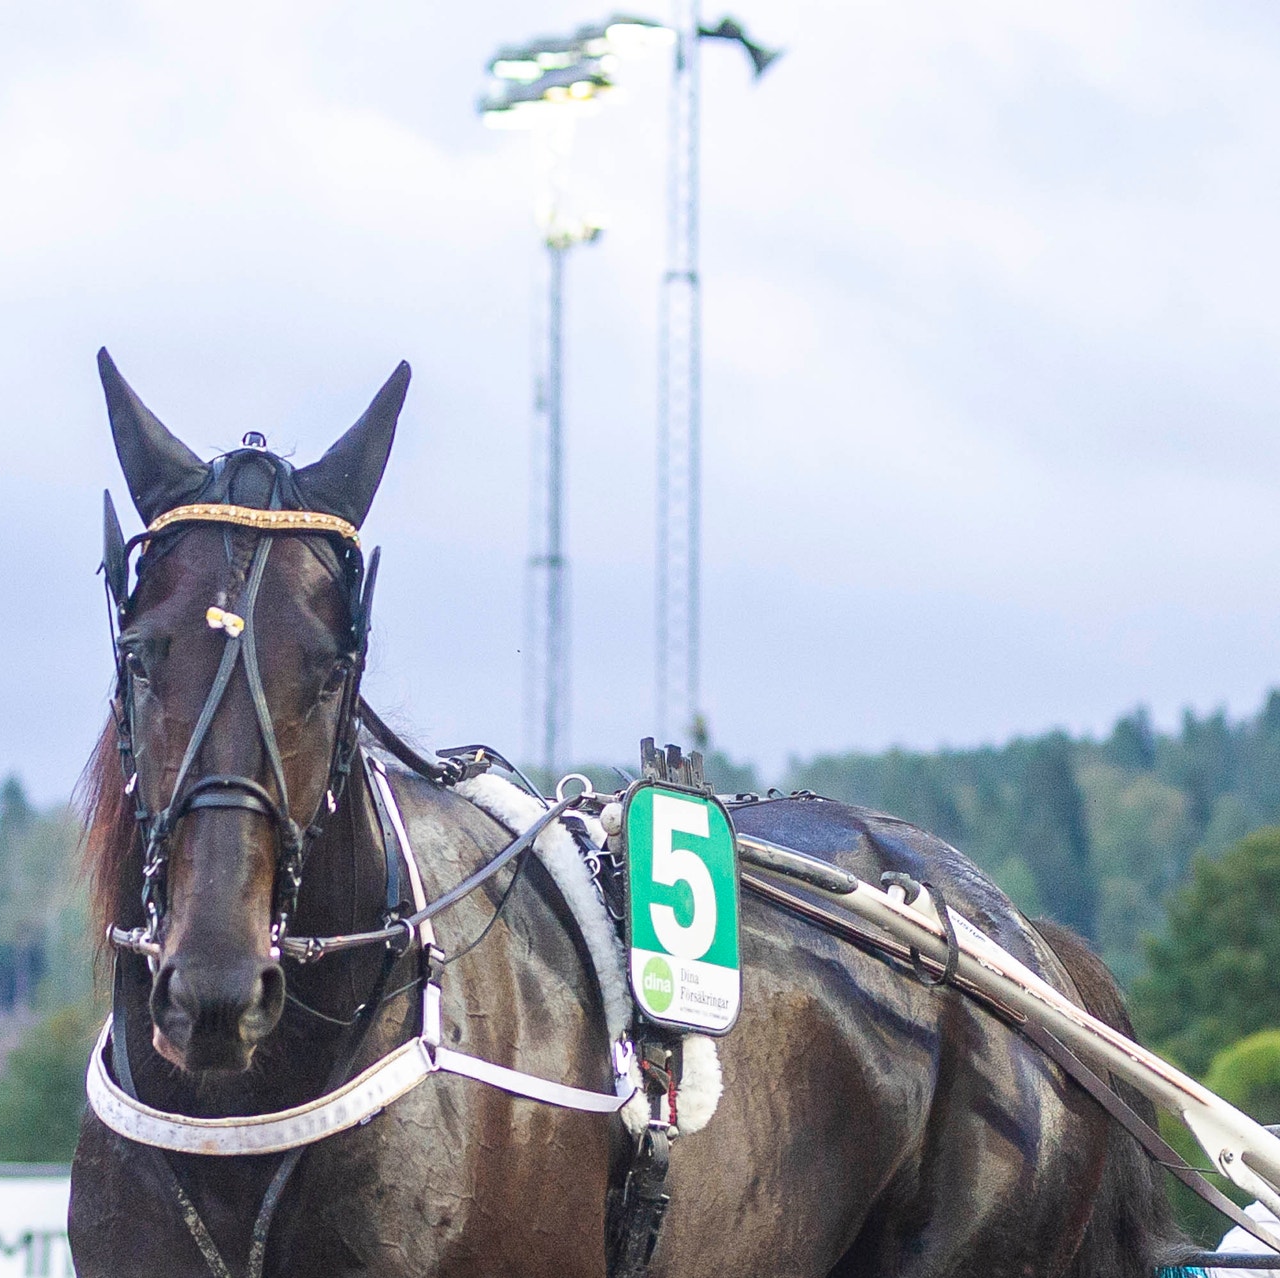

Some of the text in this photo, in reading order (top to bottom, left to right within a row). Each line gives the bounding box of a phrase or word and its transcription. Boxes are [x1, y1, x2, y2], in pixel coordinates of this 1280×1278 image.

[650, 793, 717, 960] 5
[645, 972, 671, 993] dina
[680, 968, 699, 985] Dina
[680, 986, 729, 1010] Försäkringar
